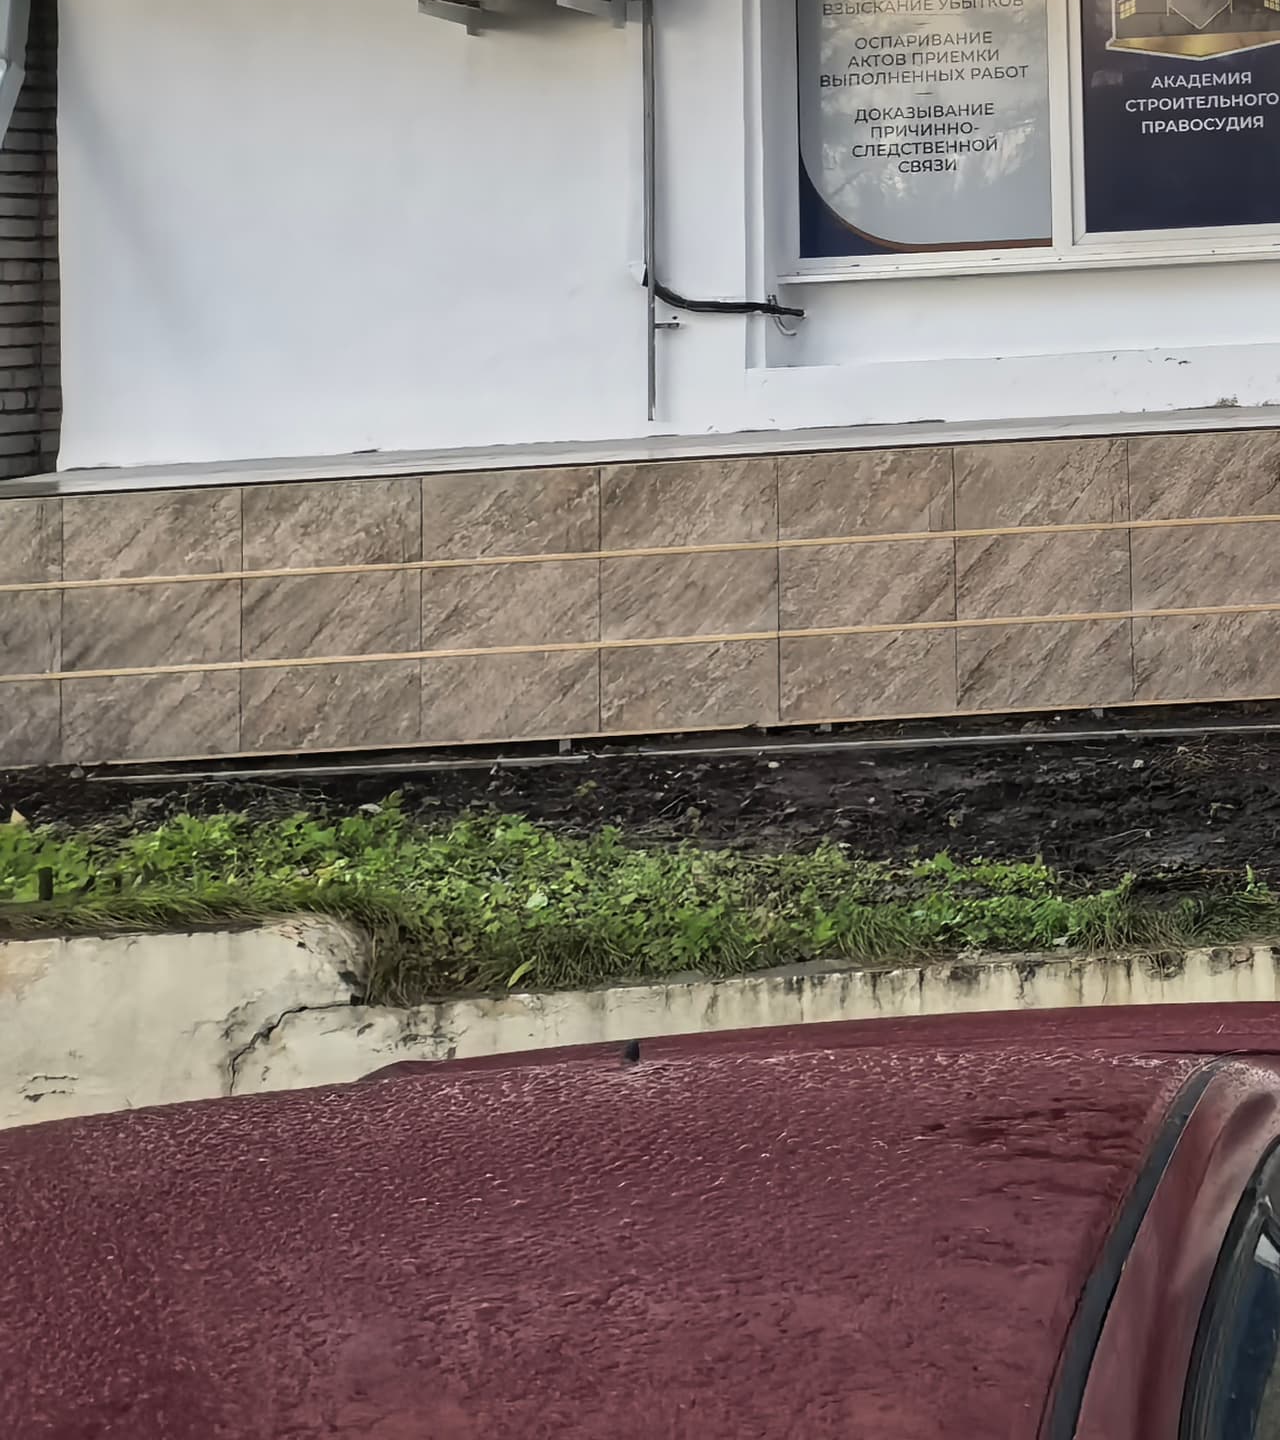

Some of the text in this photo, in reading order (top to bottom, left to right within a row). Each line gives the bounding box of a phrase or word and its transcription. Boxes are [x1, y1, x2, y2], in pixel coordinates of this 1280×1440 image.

[823, 0, 933, 15] ВЗЫСКАНИЕ
[854, 31, 993, 50] ОСПАРИВАНИЕ
[848, 49, 999, 68] АКТОВ ПРИЕМКИ
[819, 65, 1029, 87] ВЫПОЛНЕННЫХ РАБОТ
[1151, 71, 1252, 89] АКАДЕМИЯ
[1125, 92, 1279, 112] СТРОИТЕЛЬНОГО
[854, 103, 994, 124] ДОКАЗЫВАНИЕ
[870, 122, 980, 139] ПРИЧИННО-
[1141, 115, 1264, 134] ПРАВОСУДИЯ
[852, 135, 997, 158] СЛЕДСТВЕННОЙ
[898, 158, 957, 173] СВЯЗИ
